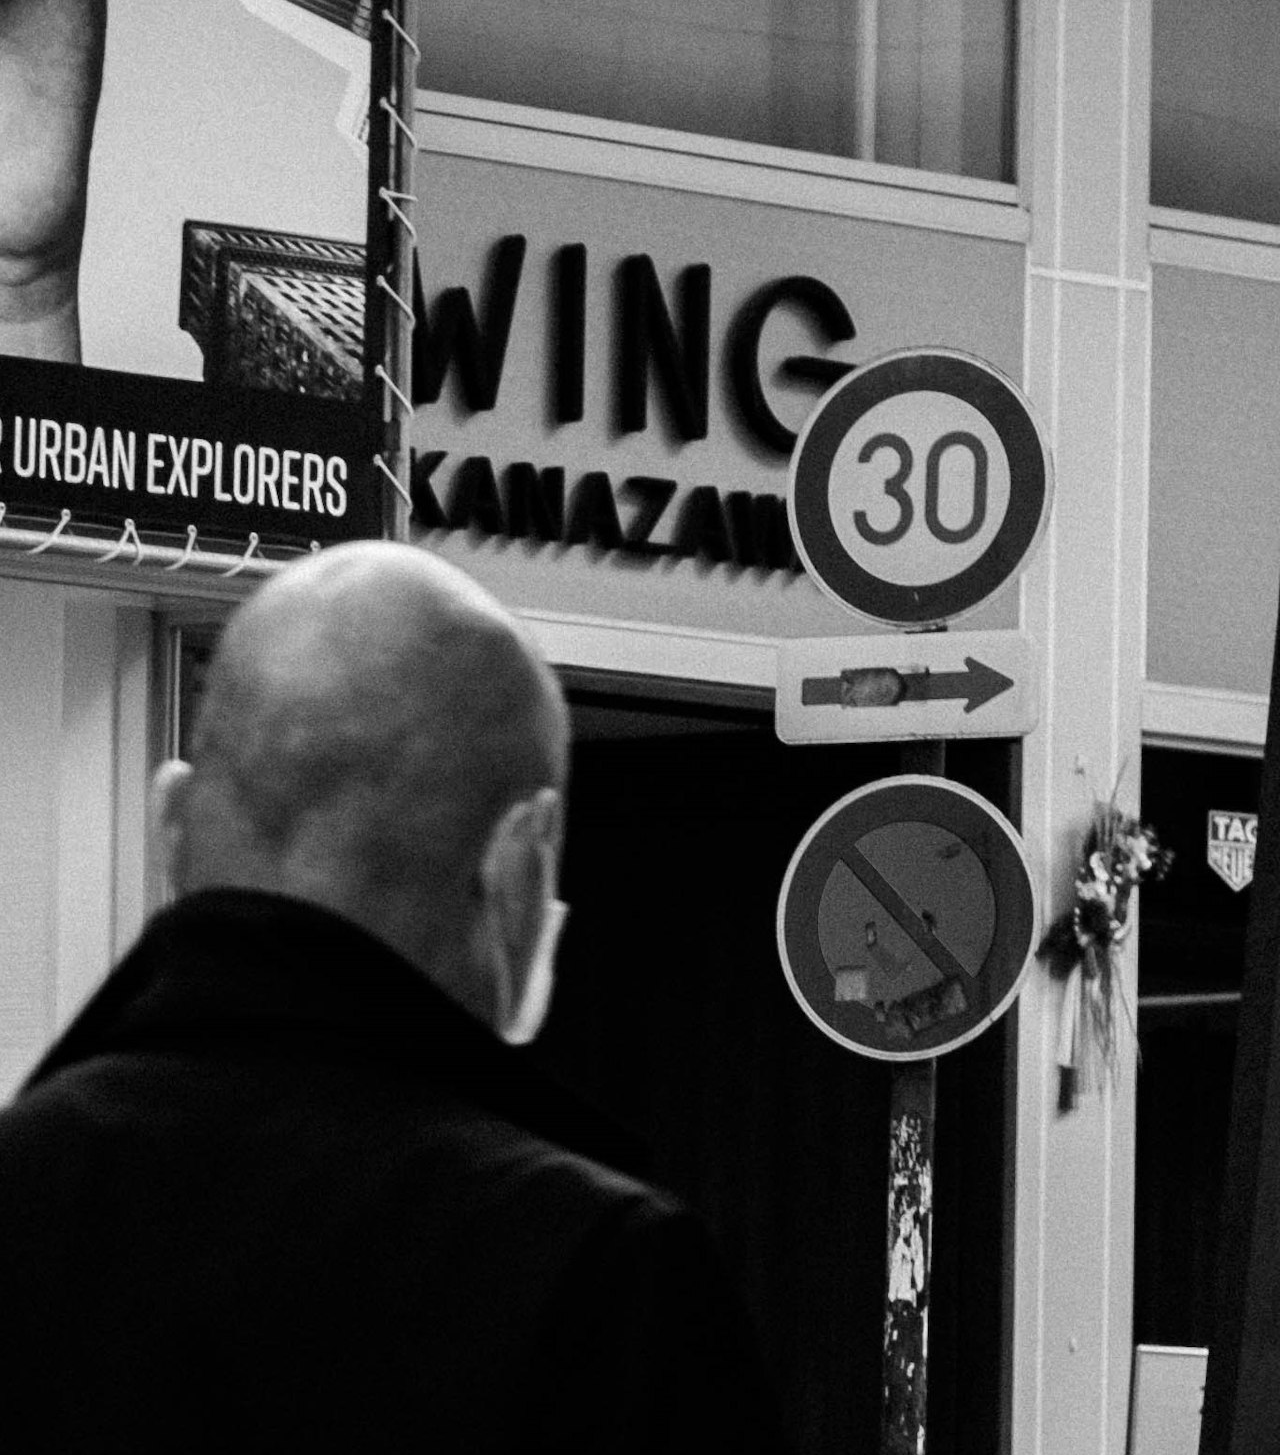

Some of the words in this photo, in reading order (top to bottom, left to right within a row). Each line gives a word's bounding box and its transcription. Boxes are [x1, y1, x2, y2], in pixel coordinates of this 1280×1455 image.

[413, 234, 857, 458] WING
[13, 416, 135, 493] URBAN
[146, 433, 348, 518] EXPLORERS
[852, 430, 990, 547] 30
